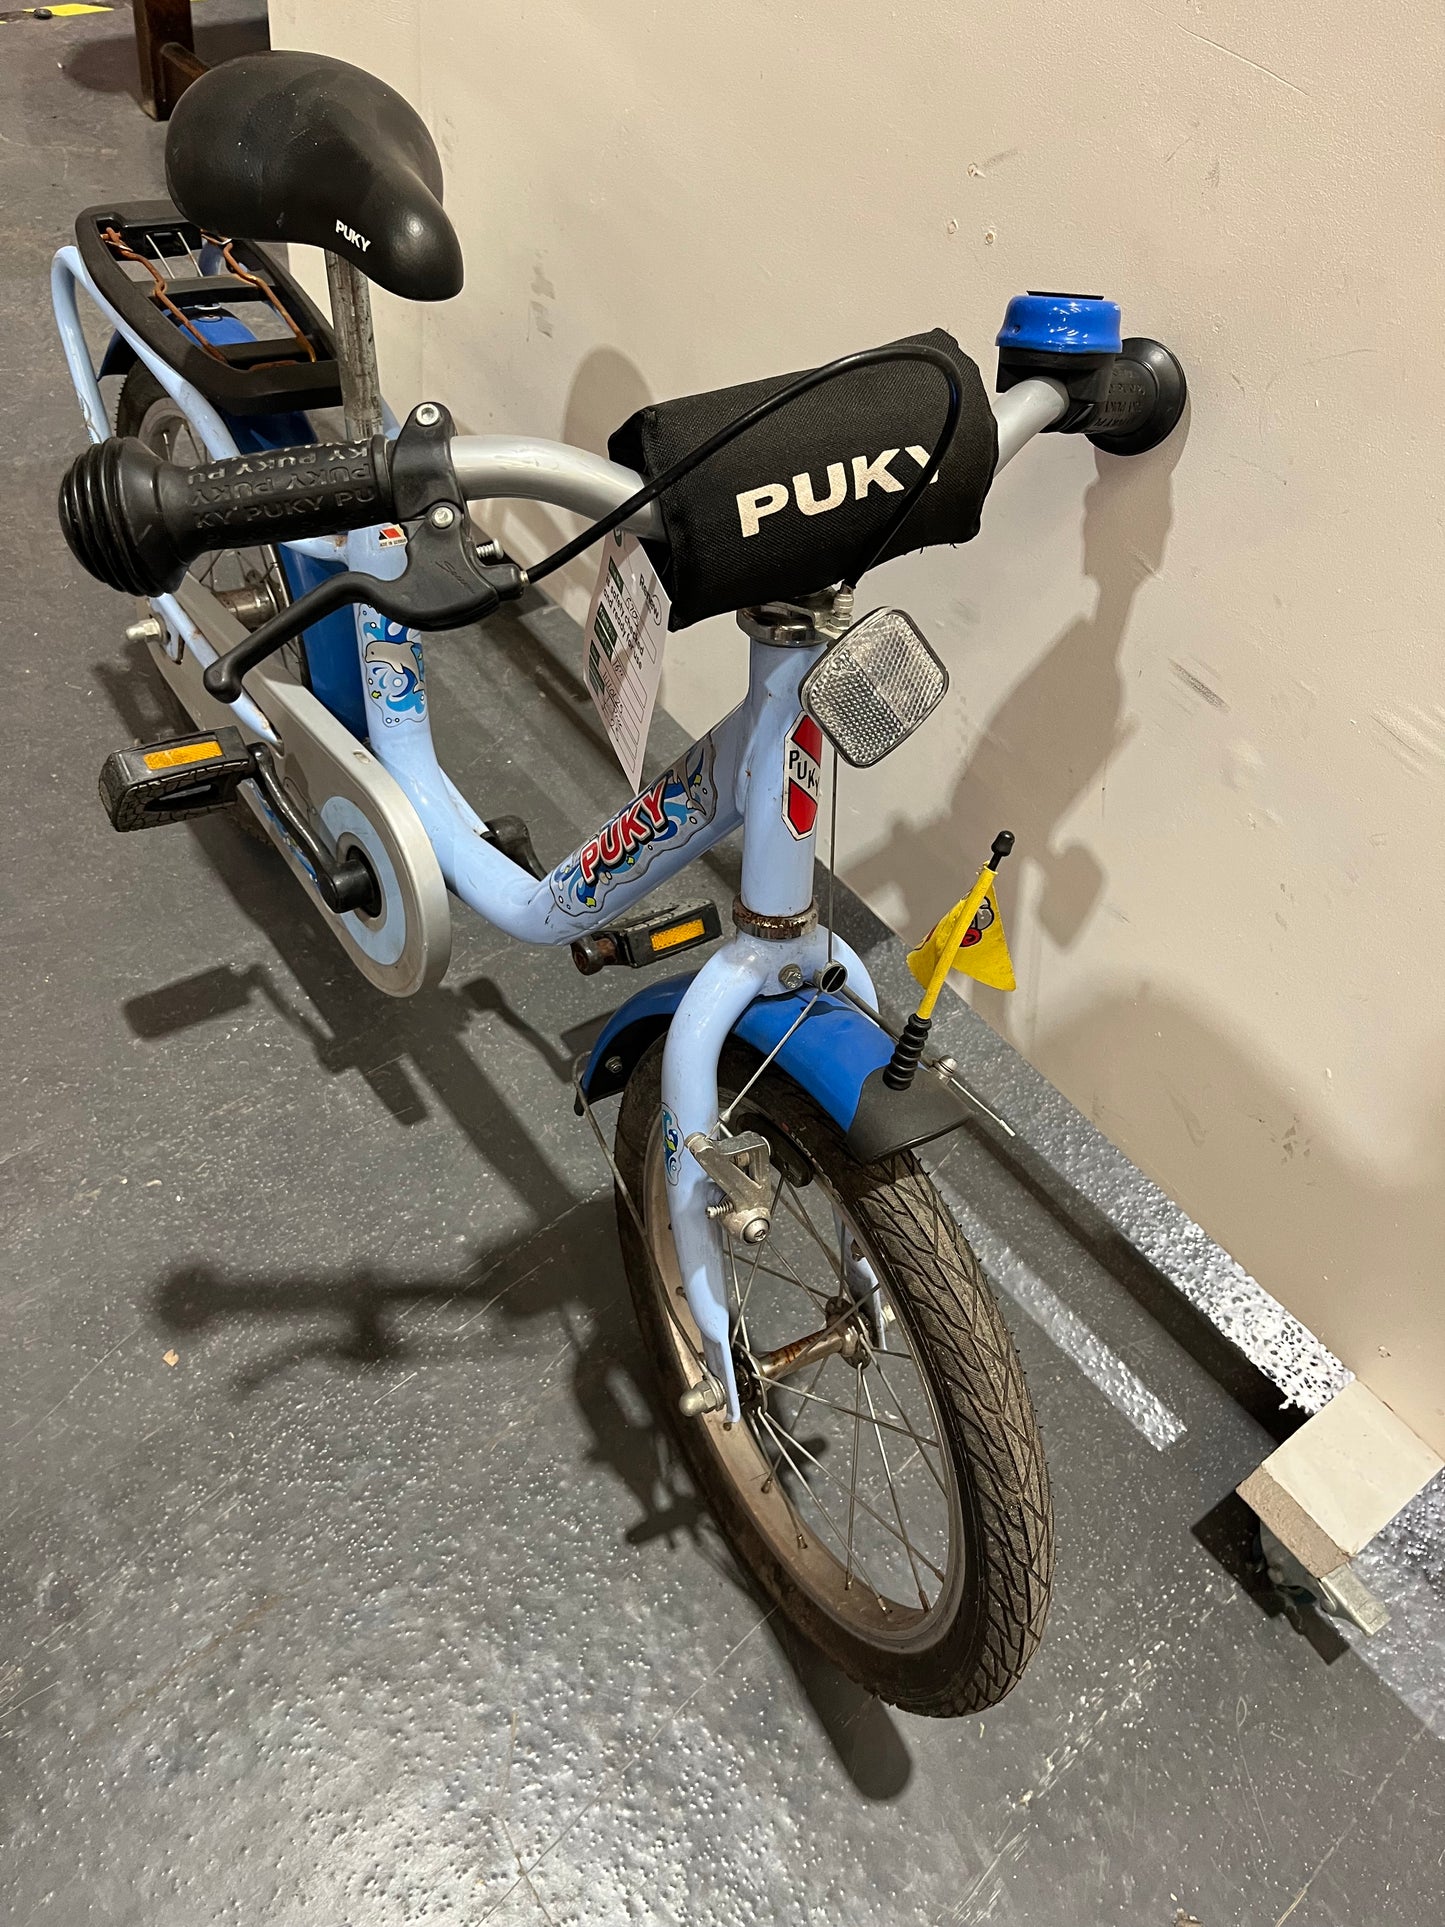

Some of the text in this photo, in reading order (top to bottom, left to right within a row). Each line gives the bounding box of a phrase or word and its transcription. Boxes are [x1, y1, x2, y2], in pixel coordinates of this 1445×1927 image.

[335, 219, 371, 252] PUKY
[236, 452, 317, 475] PUKY
[191, 463, 371, 506] PUKY PUKY
[244, 495, 324, 521] PUKY
[610, 586, 625, 618] safety
[603, 588, 614, 609] and
[613, 606, 627, 638] ready
[634, 650, 643, 670] use
[789, 750, 821, 796] PUKY
[580, 776, 668, 885] PUKY
